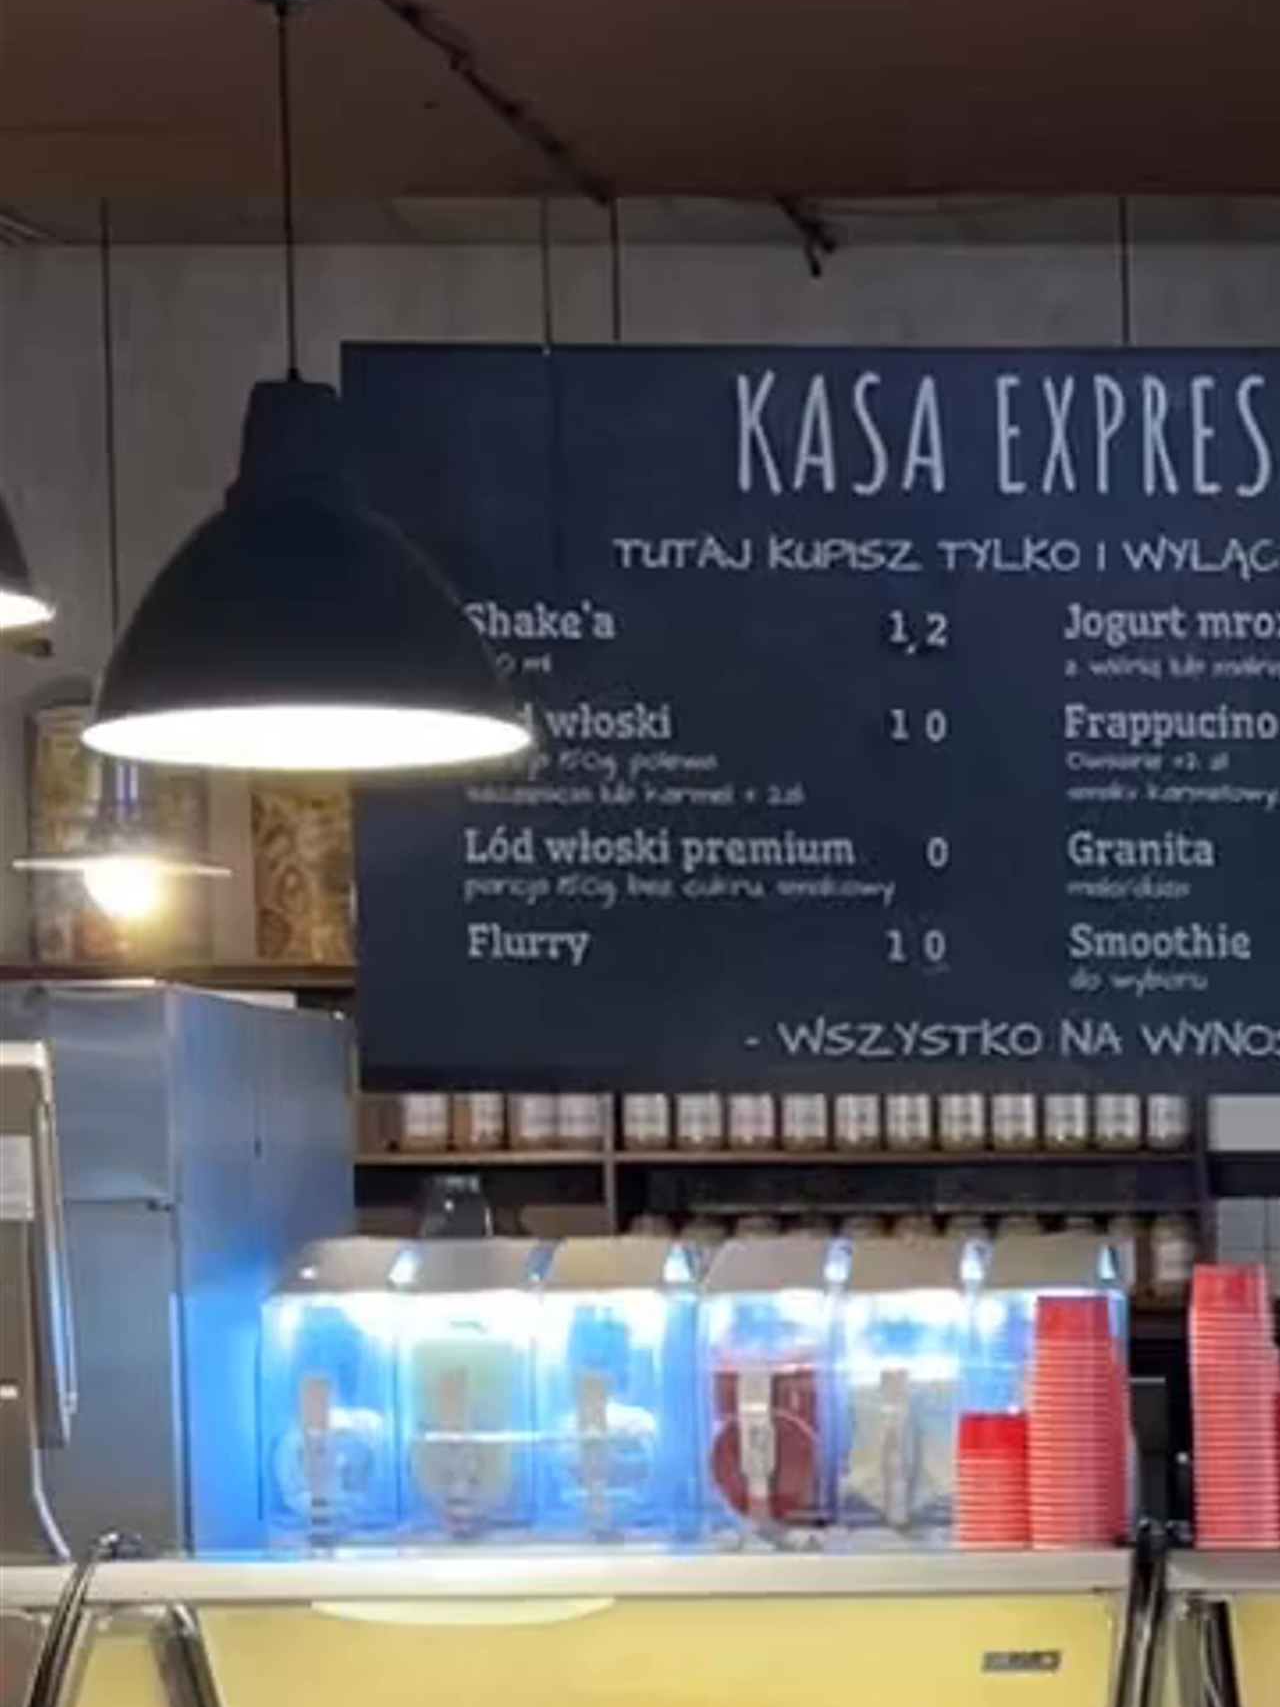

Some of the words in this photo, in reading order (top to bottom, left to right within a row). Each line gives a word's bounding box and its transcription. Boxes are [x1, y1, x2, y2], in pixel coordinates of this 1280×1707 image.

[736, 369, 947, 498] KASA
[613, 536, 752, 570] TUTAJ
[768, 535, 921, 572] KUPISZ
[938, 535, 1081, 572] TYLKO
[1096, 539, 1107, 573] I
[463, 599, 616, 640] Shake'a
[1064, 603, 1188, 648] Jogurt
[544, 702, 673, 740] włoski
[1063, 704, 1280, 748] Frappucino
[462, 825, 535, 865] Lód
[546, 826, 671, 865] włoski
[680, 830, 857, 873] premium
[1066, 830, 1216, 867] Granita
[466, 923, 592, 966] Flurry
[1068, 922, 1253, 961] Smoothie
[776, 1015, 1045, 1059] WSZYSTKO
[1057, 1019, 1123, 1056] NA
